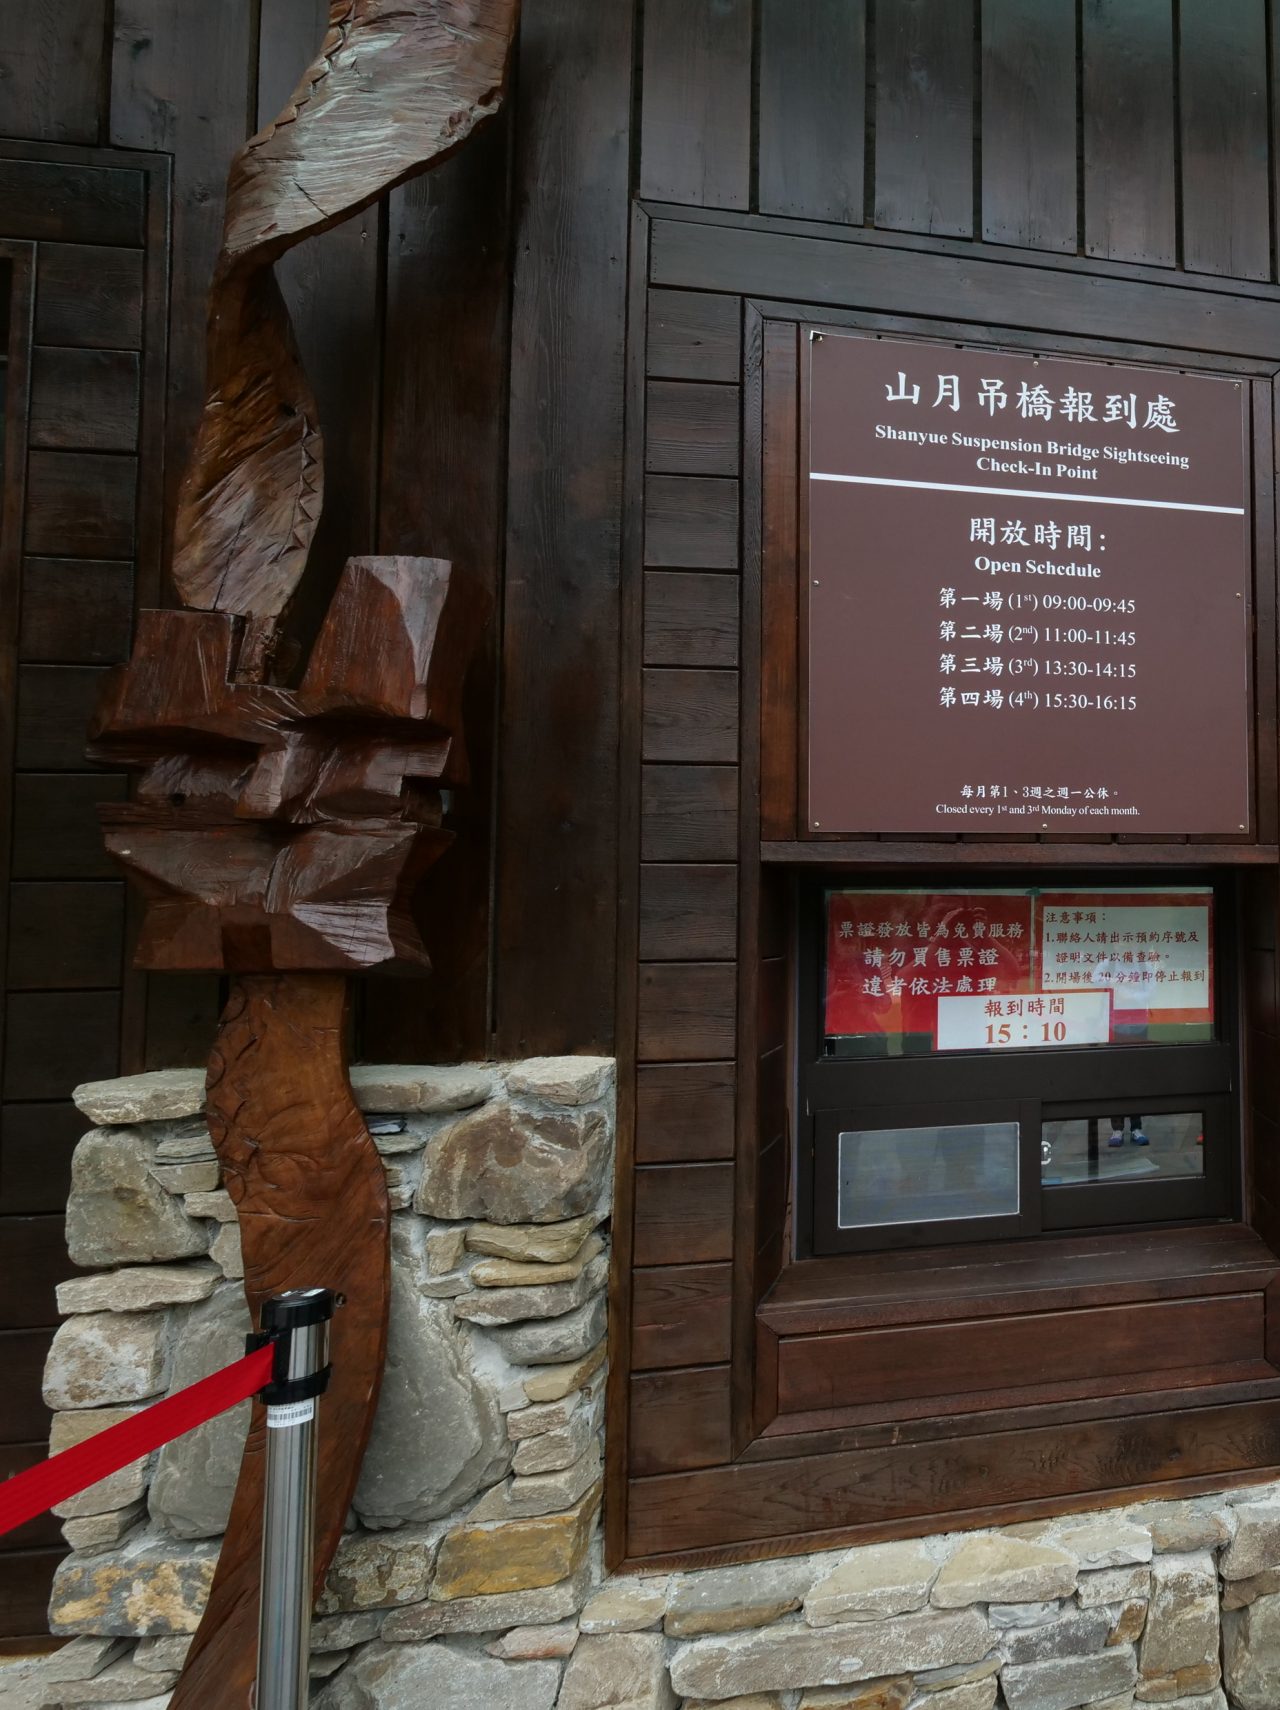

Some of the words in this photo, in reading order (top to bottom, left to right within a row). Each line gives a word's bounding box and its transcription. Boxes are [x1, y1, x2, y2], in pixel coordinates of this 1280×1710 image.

[885, 371, 1181, 433] 山月吊橋報到處
[875, 424, 948, 445] Shanyue
[951, 431, 1042, 453] Suspension
[1046, 440, 1100, 461] Bridge
[1103, 446, 1190, 469] Sightseeing
[976, 457, 1052, 477] Check-In
[1056, 463, 1098, 480] Point
[969, 517, 1106, 551] 開放時間：
[974, 556, 1021, 575] Open
[1026, 559, 1101, 578] Schedule
[939, 588, 1004, 611] 第一場
[1008, 592, 1038, 611] (1st)
[1042, 594, 1136, 613] 09:00-09:45
[939, 621, 1004, 644] 第二場
[1008, 625, 1038, 643] (2nd)
[1044, 627, 1136, 646] 11:00-11:45
[939, 653, 1004, 676] 第三場
[1008, 658, 1038, 676] (3rd)
[1044, 660, 1136, 678] 13:30-14:15
[939, 686, 1004, 709] 第四場
[1008, 691, 1038, 709] (4th)
[1045, 693, 1136, 711] 15:30-16:15
[960, 784, 1119, 799] 每月第1、3週之週一公休。
[935, 804, 968, 814] Closed
[969, 806, 994, 816] every
[1009, 805, 1025, 814] and
[1041, 805, 1077, 817] Monday
[1078, 805, 1088, 815] of
[1089, 806, 1109, 815] each
[1111, 806, 1140, 816] month.
[1046, 911, 1106, 924] 注意事項：
[839, 921, 1024, 939] 票證發放皆為免費服務
[863, 947, 999, 968] 請勿買售票證
[862, 975, 998, 997] 違者依法處理
[984, 997, 1066, 1018] 報到時間
